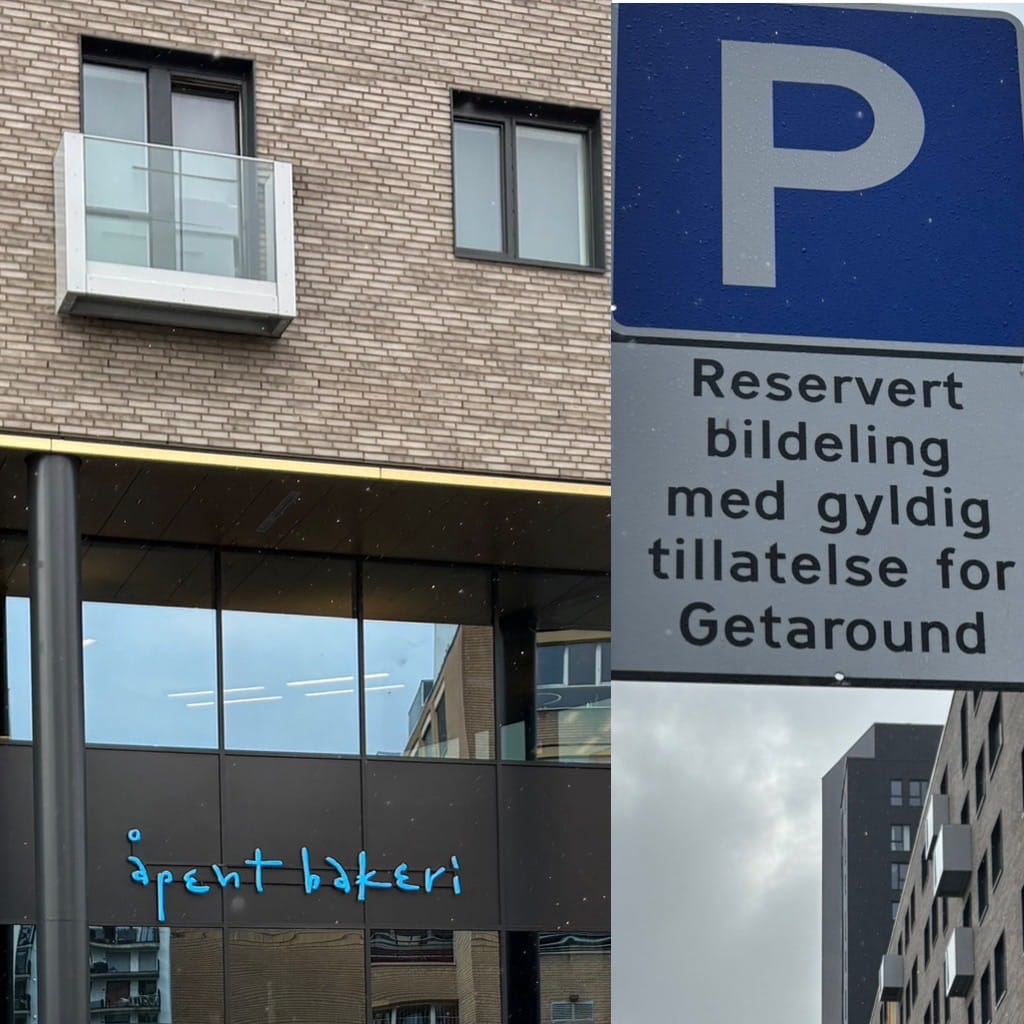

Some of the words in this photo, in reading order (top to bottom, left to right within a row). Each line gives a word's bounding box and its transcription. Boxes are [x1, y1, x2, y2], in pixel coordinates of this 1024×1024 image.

[721, 39, 925, 288] P
[692, 358, 964, 410] Reservert
[706, 417, 951, 478] bildeling
[666, 480, 786, 521] med
[817, 485, 992, 541] gyldig
[647, 537, 909, 590] tillatelse
[936, 547, 1016, 591] for
[678, 601, 987, 655] Getaround
[128, 829, 284, 923] åpent
[301, 846, 461, 902] bakeri
